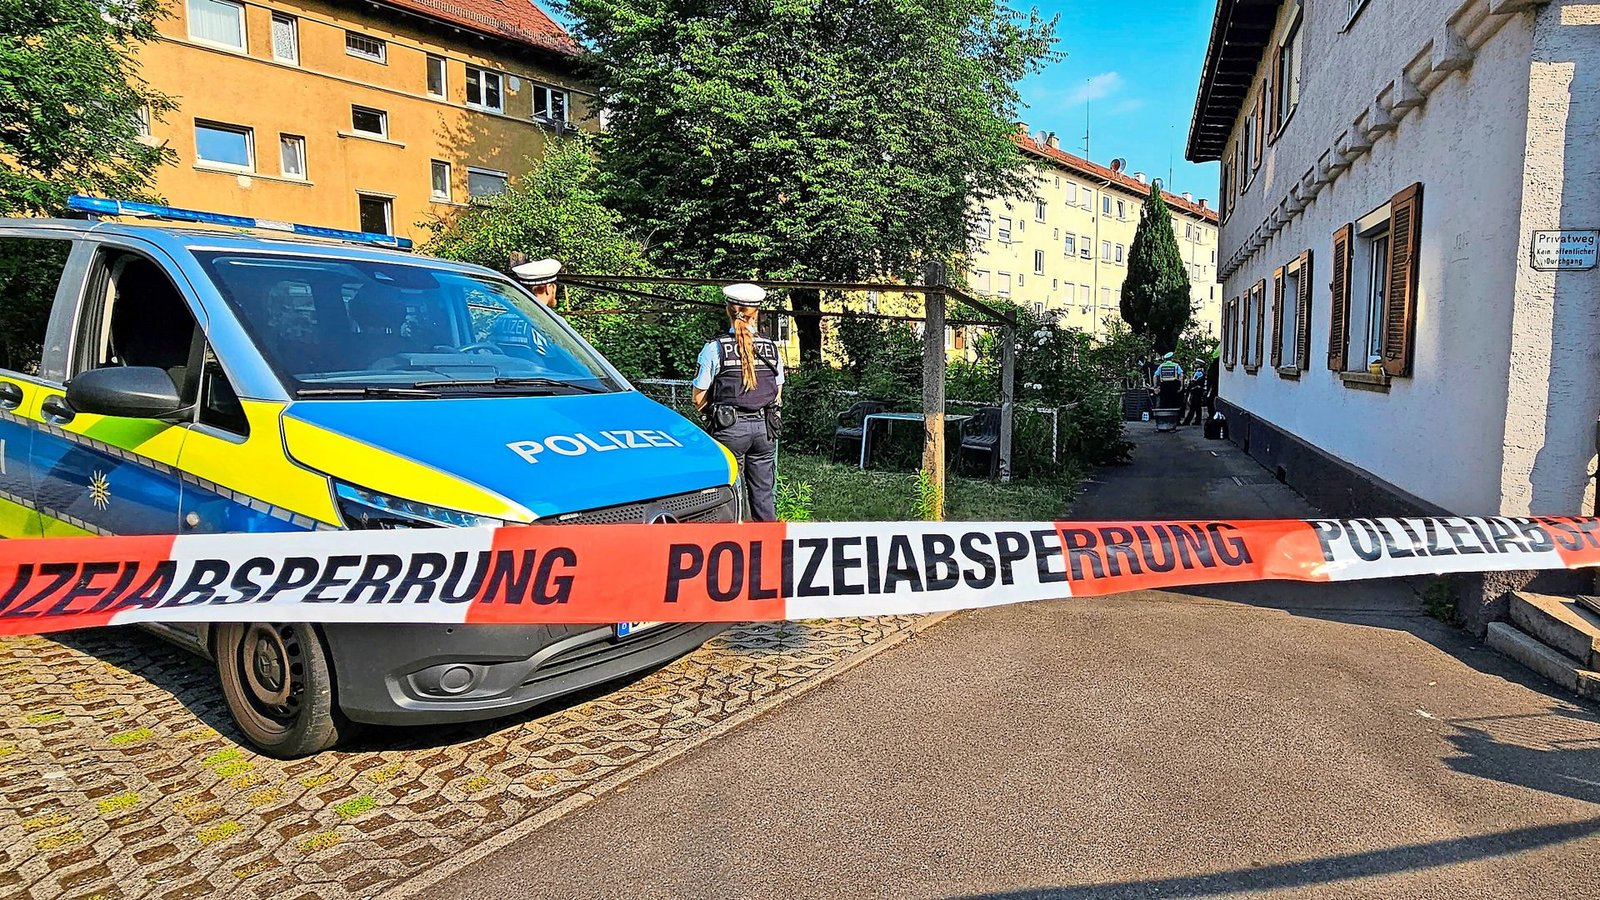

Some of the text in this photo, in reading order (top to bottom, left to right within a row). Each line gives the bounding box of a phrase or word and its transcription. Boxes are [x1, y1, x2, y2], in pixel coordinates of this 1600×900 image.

[1538, 234, 1595, 246] Privatweg
[1546, 257, 1583, 266] Durchgang
[505, 430, 684, 465] POLIZEI
[663, 521, 1254, 604] POLIZEIABSPERRUNG
[0, 547, 578, 618] IZEIABSPERRUNG
